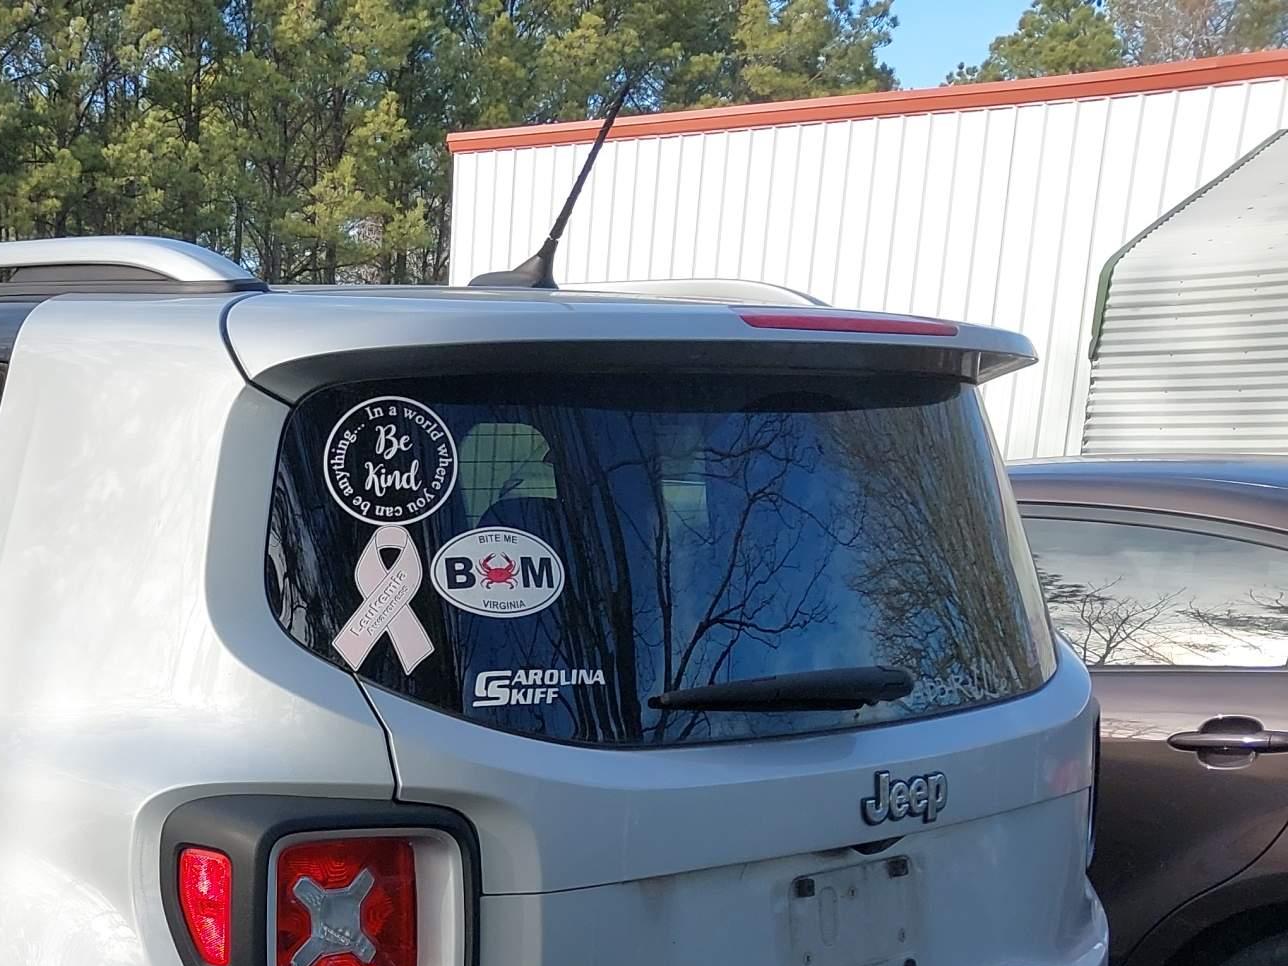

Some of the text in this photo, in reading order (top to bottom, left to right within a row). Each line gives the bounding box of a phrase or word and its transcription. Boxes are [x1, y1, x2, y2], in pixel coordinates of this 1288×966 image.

[375, 424, 413, 460] Be
[330, 406, 453, 517] In a world where you can be anything...
[364, 459, 422, 497] Kind
[478, 534, 518, 544] BITE ME
[482, 599, 527, 610] VIRGINIA
[472, 680, 559, 708] SKIFF
[474, 669, 606, 697] CAROLINA
[861, 770, 948, 826] Jeep
